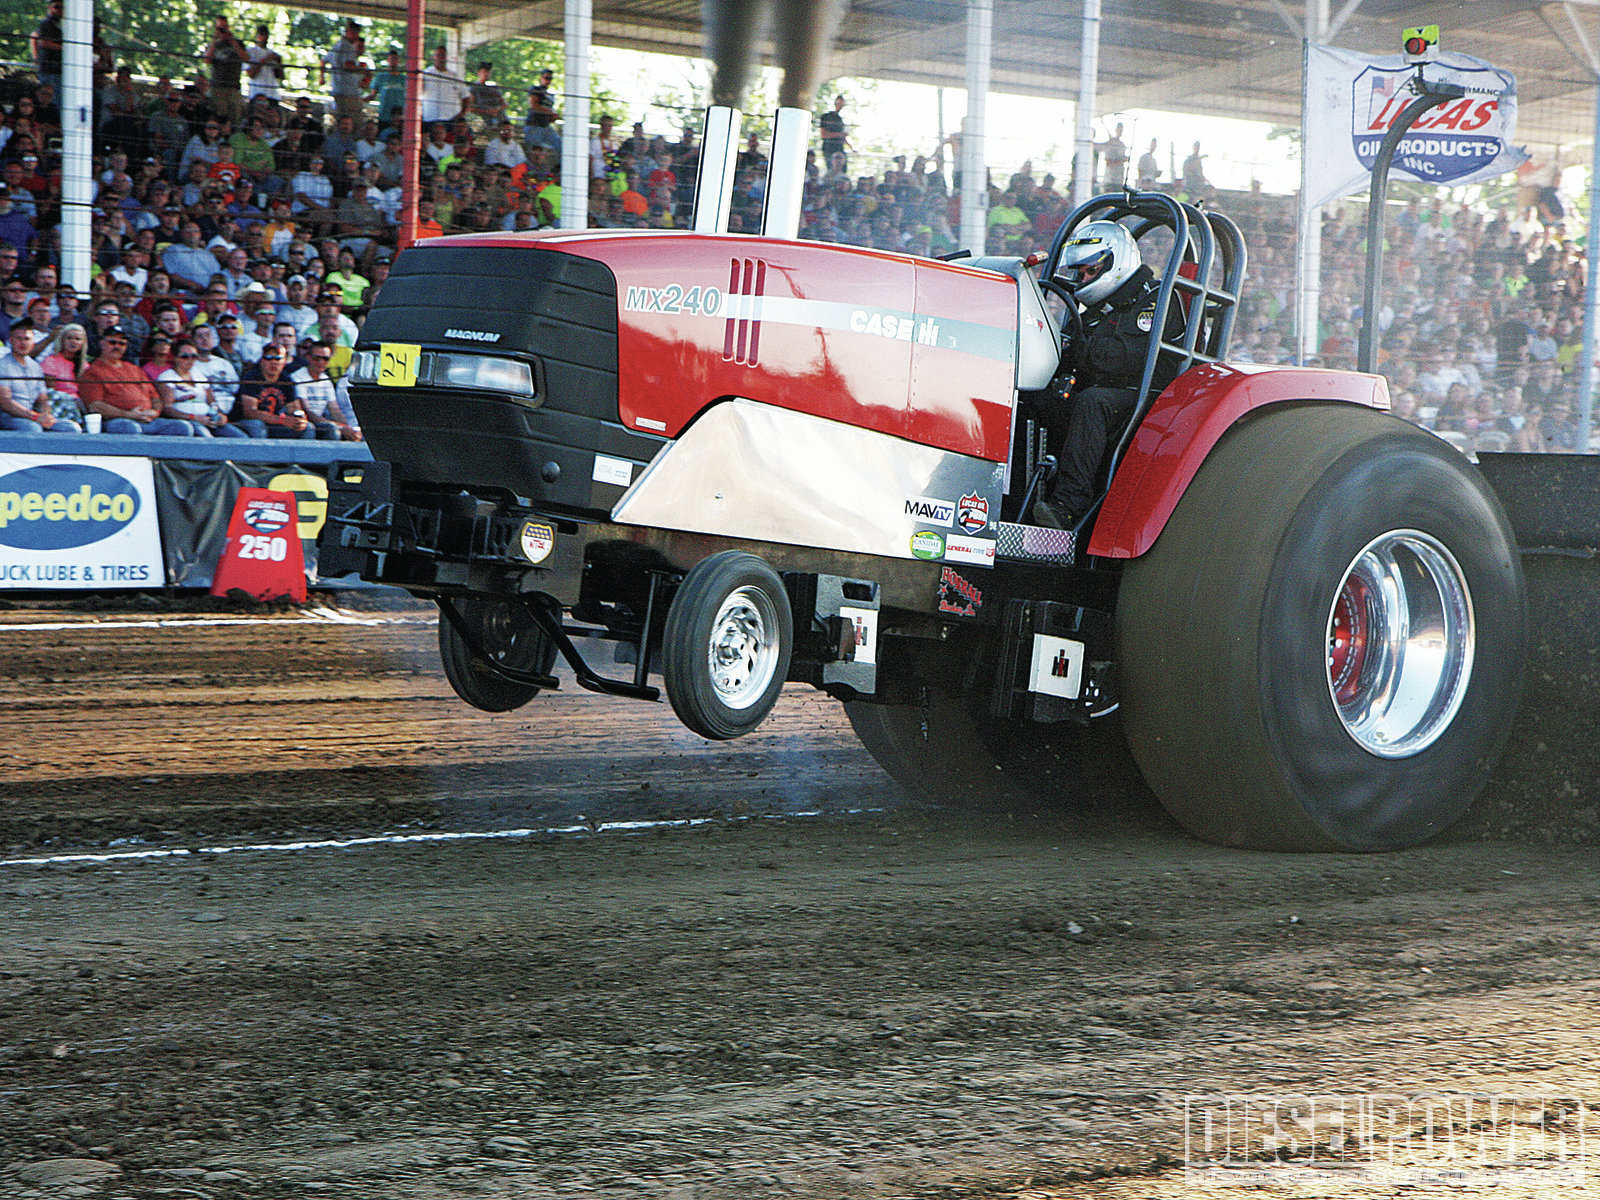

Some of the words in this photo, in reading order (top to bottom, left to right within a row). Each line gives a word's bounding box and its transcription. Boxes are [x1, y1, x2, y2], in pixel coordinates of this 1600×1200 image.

[1395, 139, 1499, 157] RODUCTS
[1402, 156, 1442, 176] INC.
[624, 283, 721, 316] MX240
[444, 329, 500, 342] MAGNUM
[849, 309, 915, 342] CASE
[382, 352, 408, 381] 24
[0, 484, 135, 527] peedco
[238, 534, 287, 561] 250
[0, 565, 31, 581] UCK
[37, 565, 78, 581] LUBE
[83, 566, 95, 580] &
[101, 565, 149, 581] TIRES
